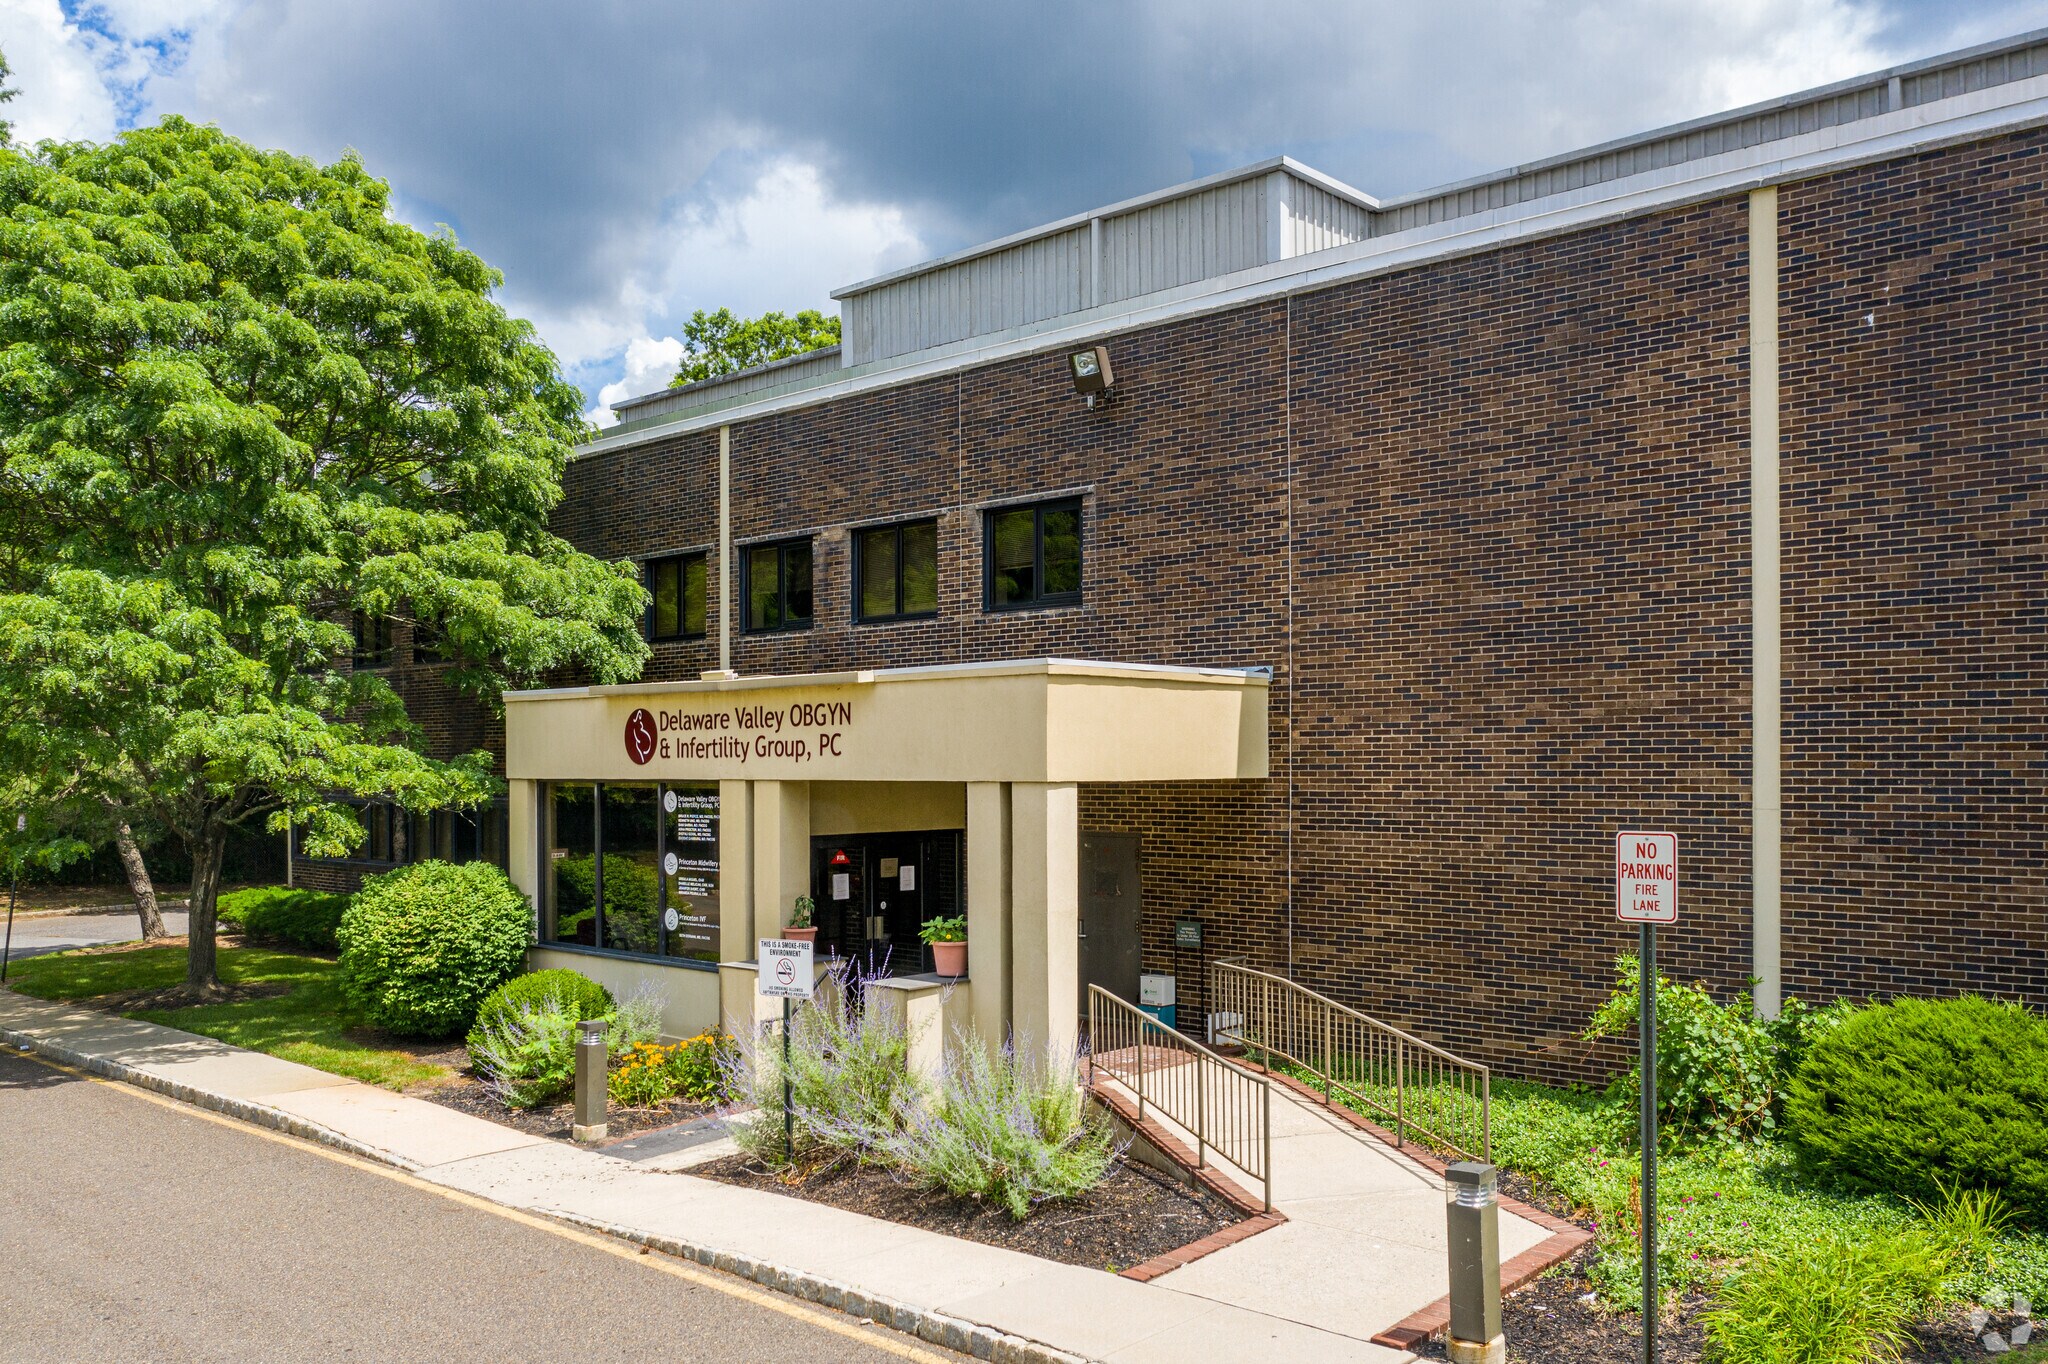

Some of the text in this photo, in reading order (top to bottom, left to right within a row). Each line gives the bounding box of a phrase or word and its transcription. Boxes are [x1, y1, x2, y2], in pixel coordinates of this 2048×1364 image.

[659, 702, 851, 733] Delaware Valley OBGYN
[659, 733, 842, 763] & Infertility Group, PC
[1636, 842, 1657, 859] NO
[698, 860, 718, 868] Midwifery
[1621, 862, 1673, 881] PARKING
[1635, 884, 1659, 896] FIRE
[1633, 899, 1661, 912] LANE
[770, 949, 801, 957] ENVIRONMENT
